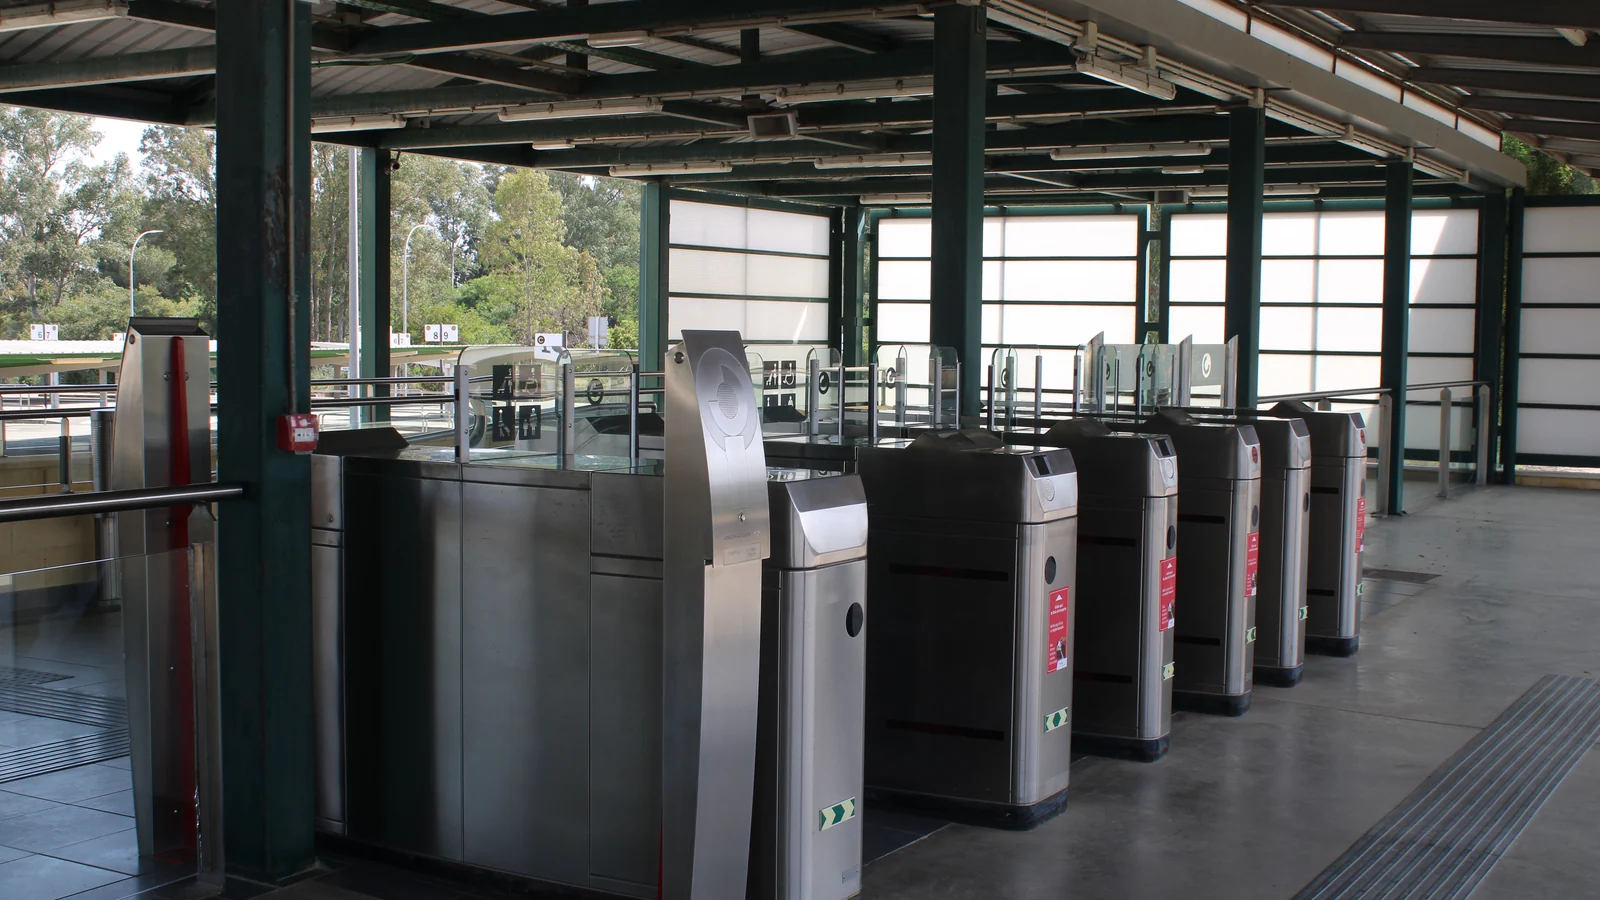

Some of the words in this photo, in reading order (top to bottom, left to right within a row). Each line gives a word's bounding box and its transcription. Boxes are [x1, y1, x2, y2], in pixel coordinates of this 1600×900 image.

[38, 331, 42, 339] 6
[46, 331, 50, 339] 7
[433, 331, 439, 340] 8
[443, 331, 449, 340] 9
